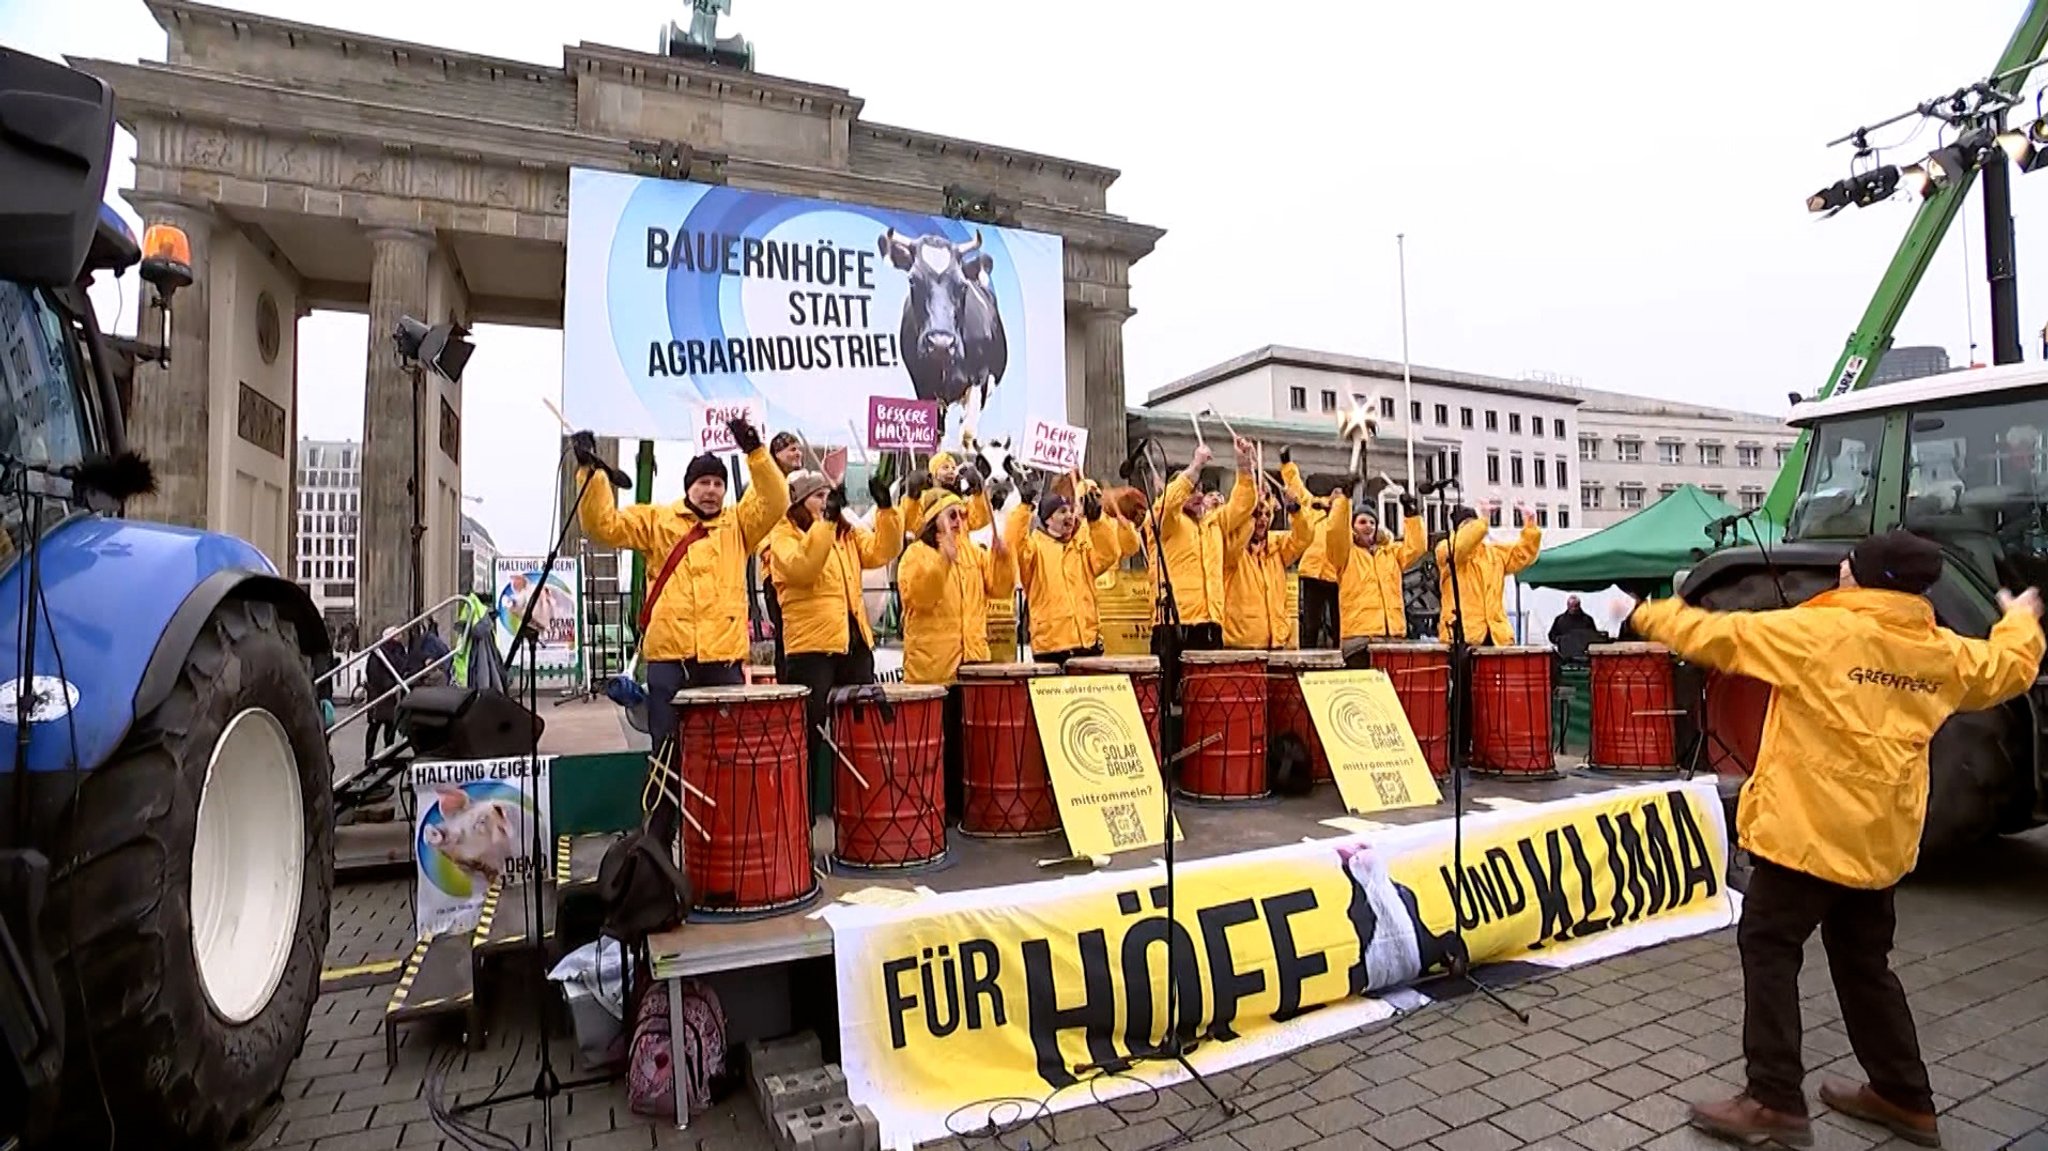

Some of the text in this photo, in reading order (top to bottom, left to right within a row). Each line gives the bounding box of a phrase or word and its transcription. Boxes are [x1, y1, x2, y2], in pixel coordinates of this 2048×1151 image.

[646, 227, 875, 290] BAUERNHÖFE
[788, 291, 872, 328] STATT
[648, 333, 899, 377] AGRARINDUSTRIE!
[706, 407, 751, 426] FAIRE
[877, 404, 928, 424] BESSERE
[701, 424, 766, 447] PRE!
[1036, 421, 1076, 444] MEHR
[499, 560, 539, 572] HALTUNG
[1035, 683, 1128, 696] www.solardrums.de
[1102, 743, 1138, 761] SOLAR
[416, 762, 485, 785] HALTUNG
[1106, 760, 1145, 777] DRUMS
[1070, 785, 1153, 807] mittrommeln?
[883, 790, 1718, 1090] FÜR HÖFE UND KLIMA
